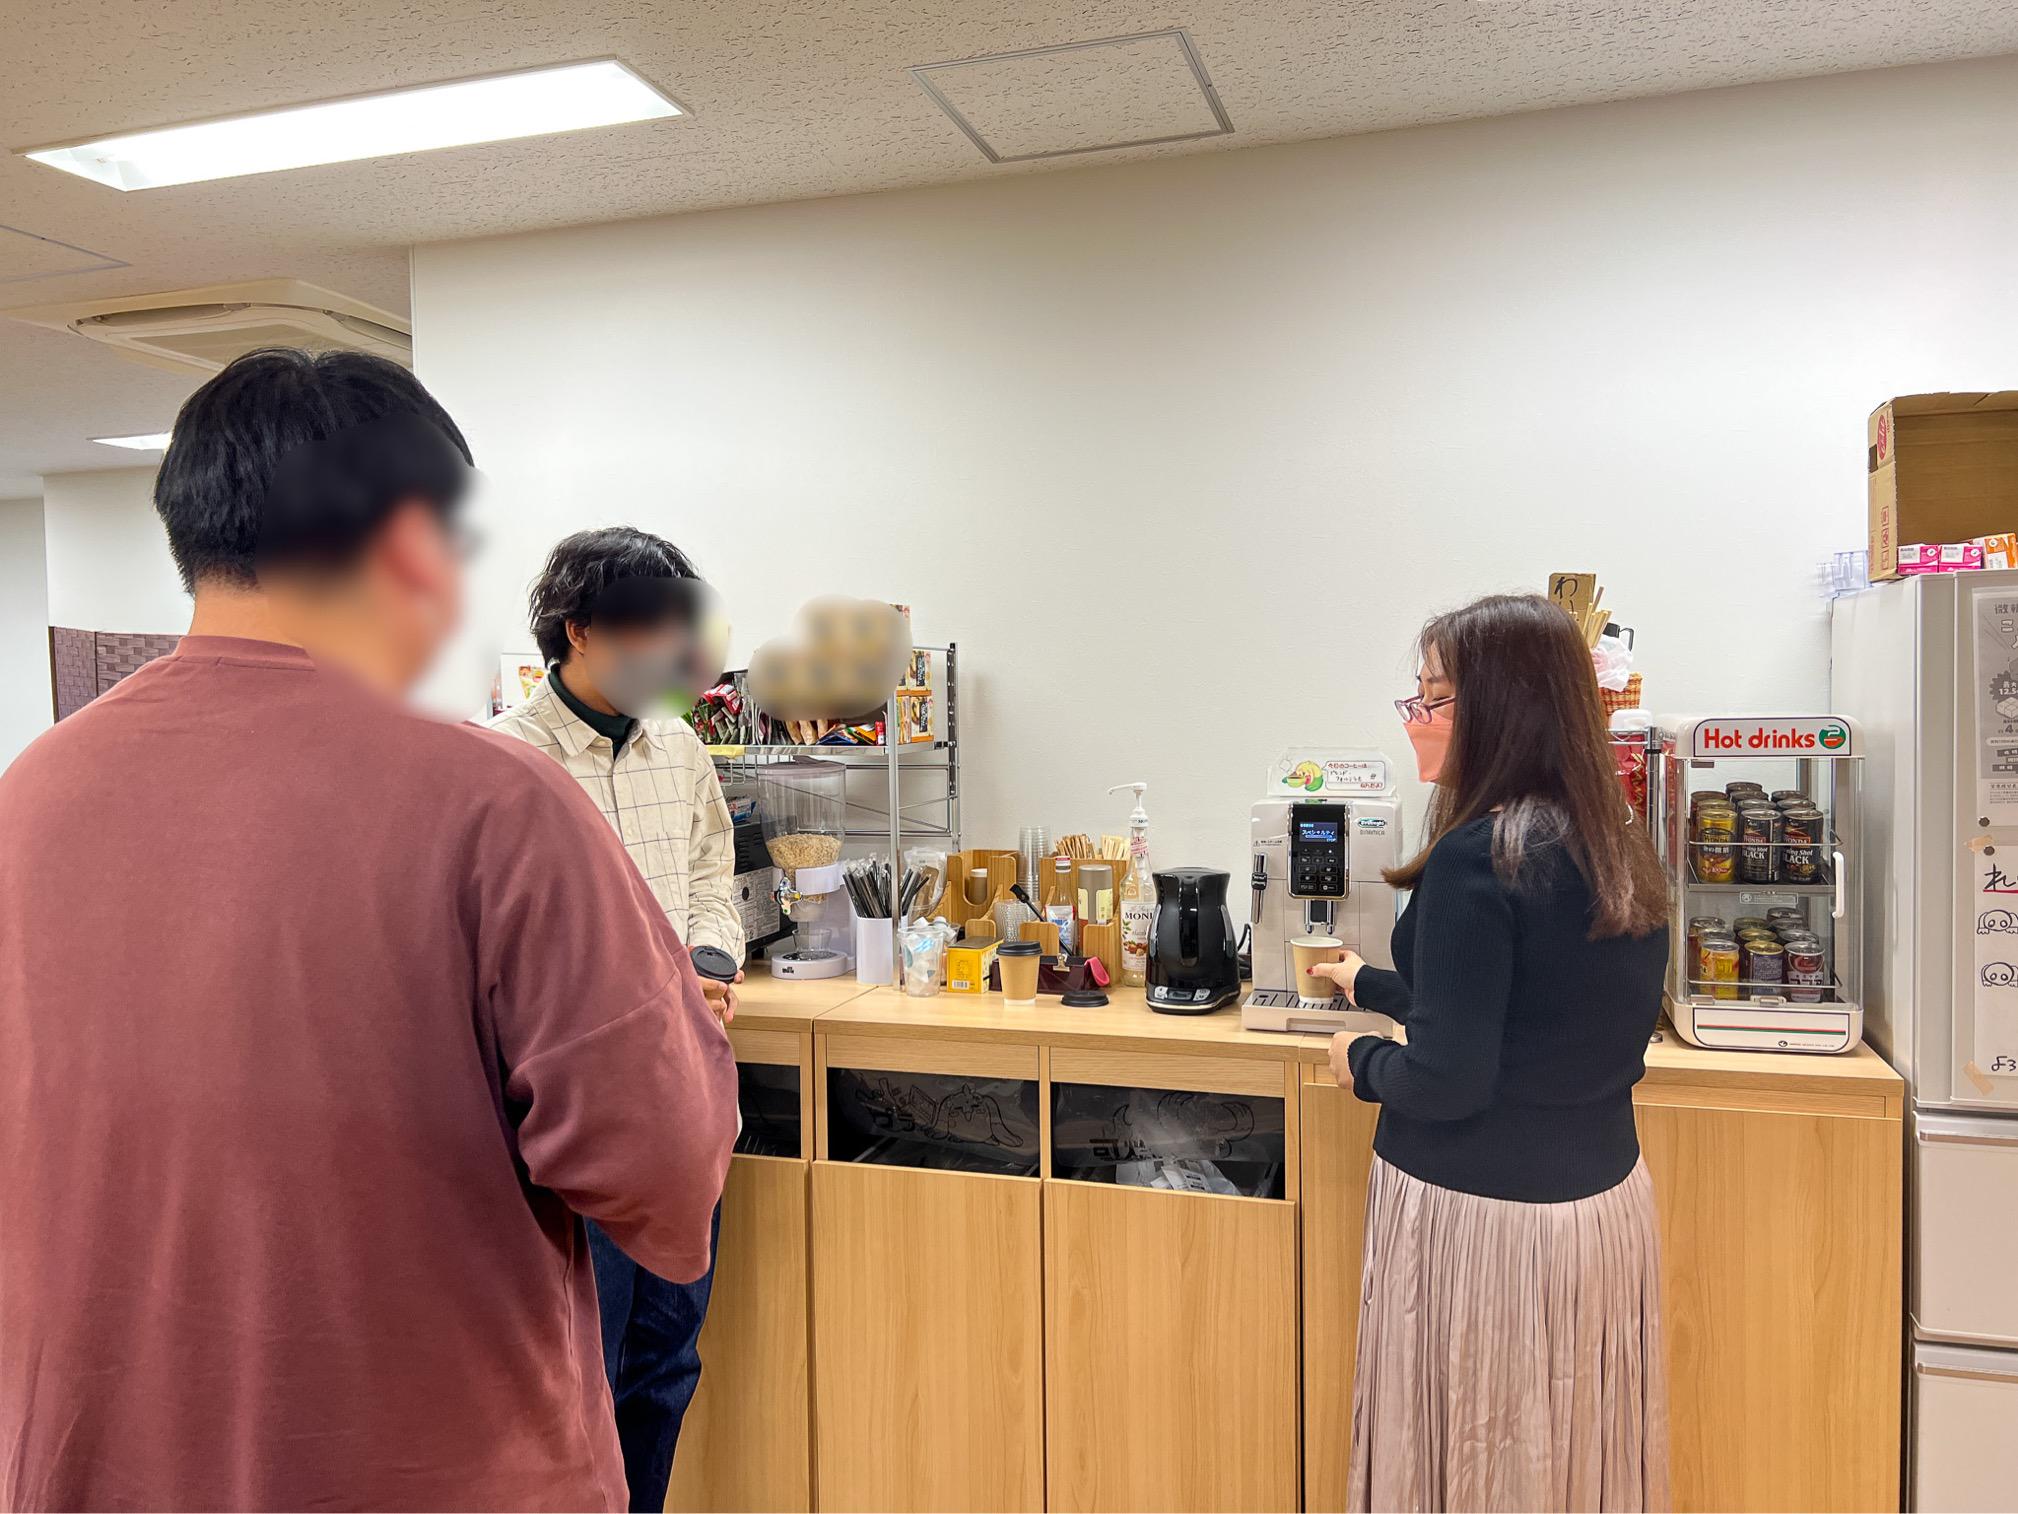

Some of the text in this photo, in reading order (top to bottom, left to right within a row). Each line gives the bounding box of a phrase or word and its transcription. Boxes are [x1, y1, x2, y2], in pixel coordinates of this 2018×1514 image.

[1704, 728, 1815, 749] Hot drinks
[1784, 854, 1810, 865] LACK
[1984, 863, 2018, 891] れ
[1124, 912, 1153, 921] MONI
